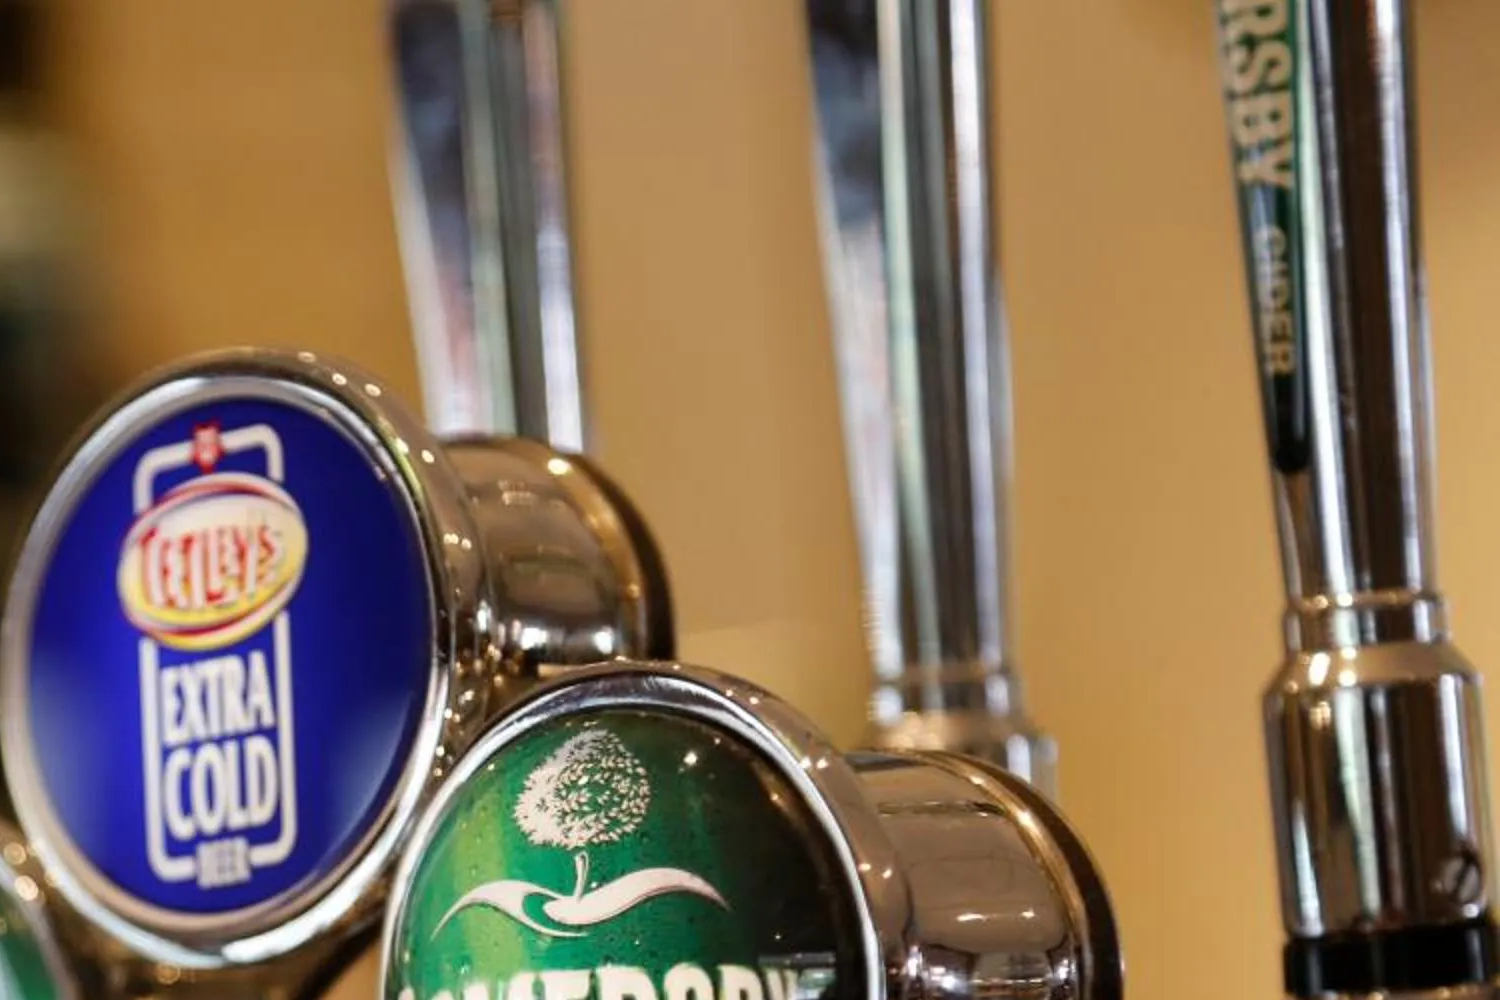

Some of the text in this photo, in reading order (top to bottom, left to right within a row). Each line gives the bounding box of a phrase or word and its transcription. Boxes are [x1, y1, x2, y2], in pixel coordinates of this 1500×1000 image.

[1255, 225, 1296, 376] CIDER
[162, 652, 274, 743] EXTRA
[164, 738, 277, 840] COLD
